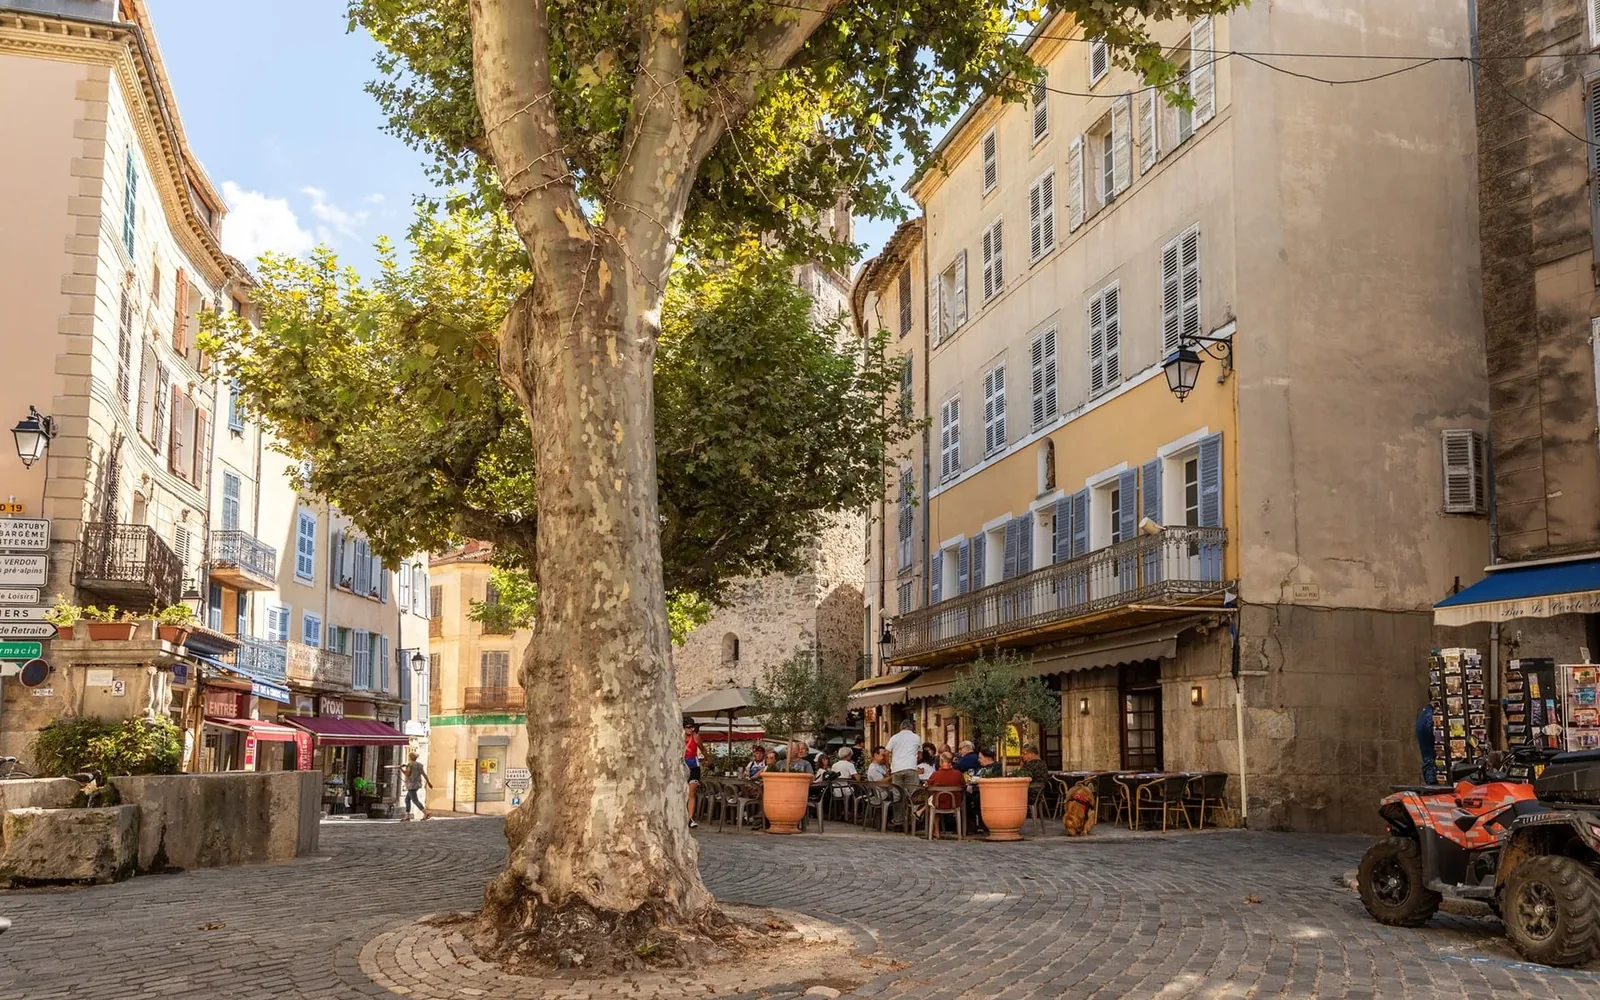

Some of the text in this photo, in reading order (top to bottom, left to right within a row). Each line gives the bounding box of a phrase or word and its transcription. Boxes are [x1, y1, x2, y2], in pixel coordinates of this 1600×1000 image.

[11, 504, 22, 512] 19
[4, 558, 38, 566] VERDON
[3, 567, 43, 575] pré-alpins
[8, 592, 34, 600] Loisirs
[1501, 607, 1524, 617] Bar
[1532, 603, 1544, 613] Le
[1551, 600, 1584, 611] Cercle
[11, 626, 48, 635] Retraite
[209, 700, 238, 718] ENTRÉE
